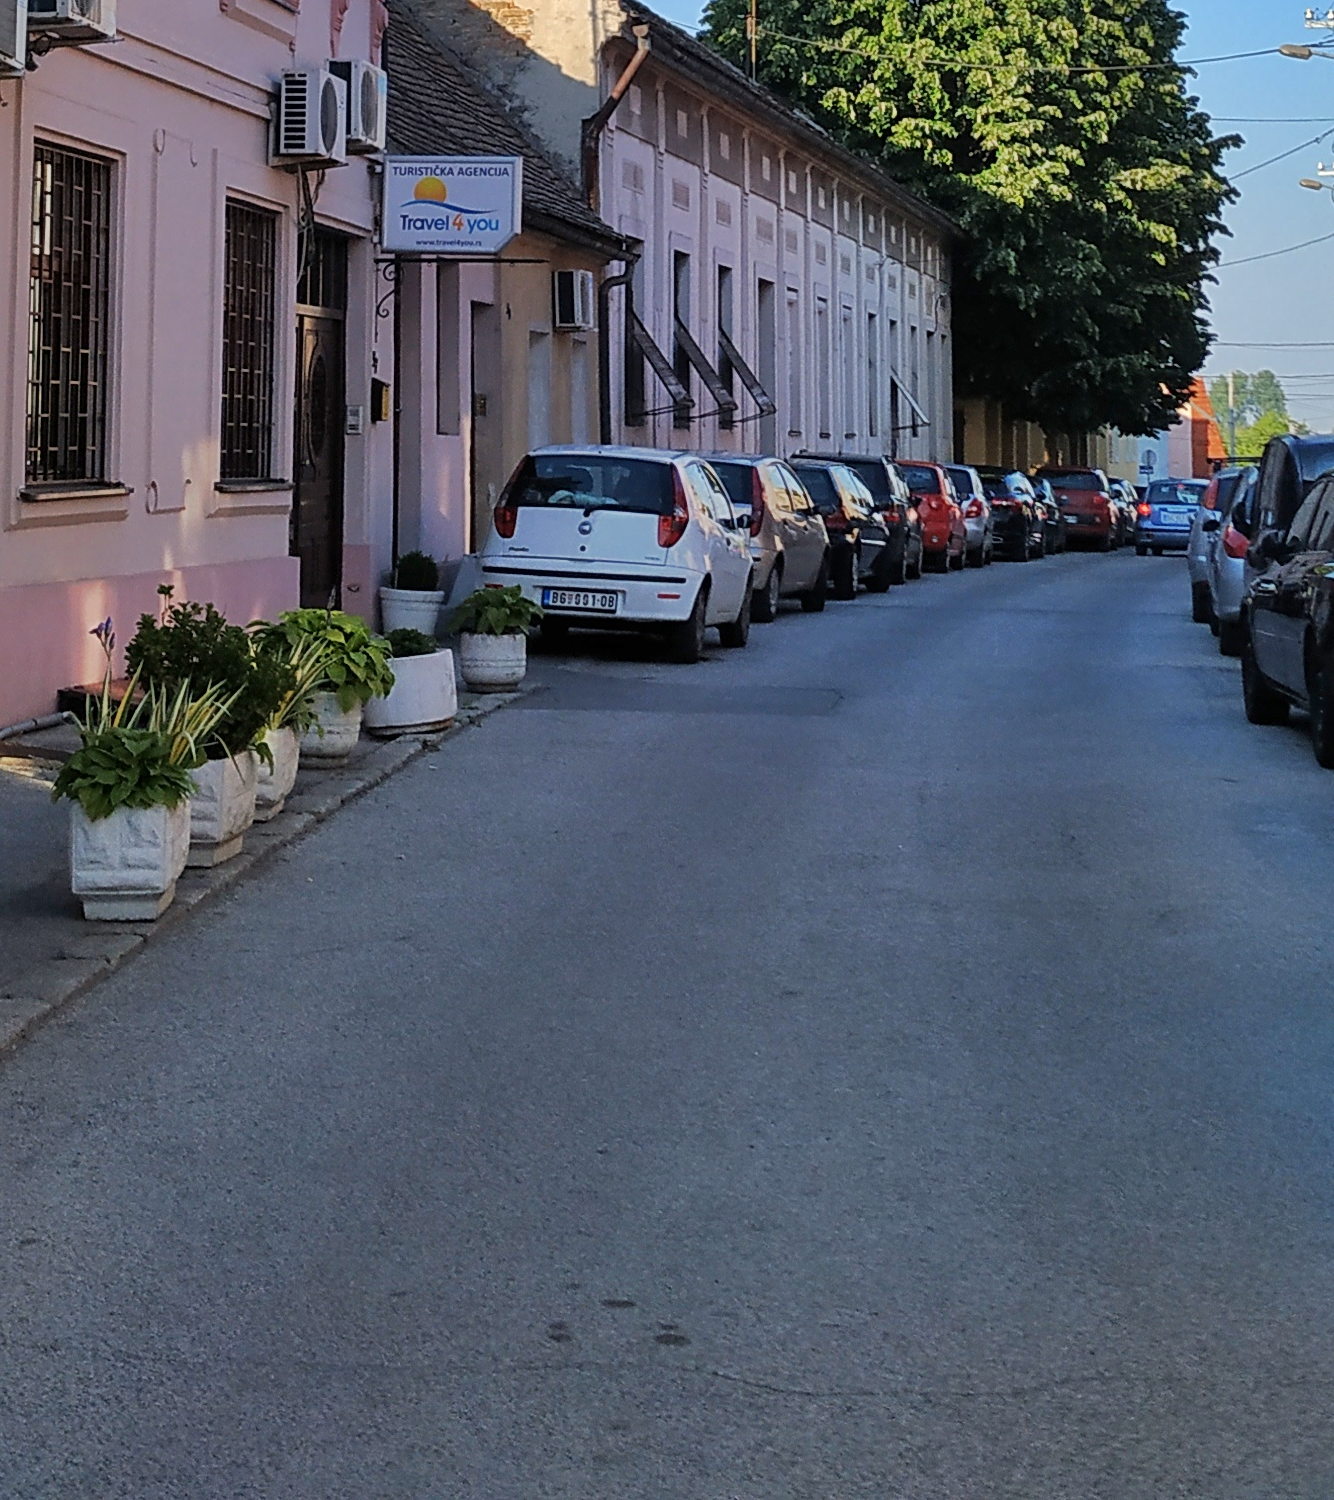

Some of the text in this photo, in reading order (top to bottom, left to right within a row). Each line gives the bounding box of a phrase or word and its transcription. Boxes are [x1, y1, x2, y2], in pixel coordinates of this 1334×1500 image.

[392, 165, 510, 177] TURISTIČKA AGENCIJA
[400, 213, 500, 235] Travel 4 you
[551, 591, 567, 605] BG
